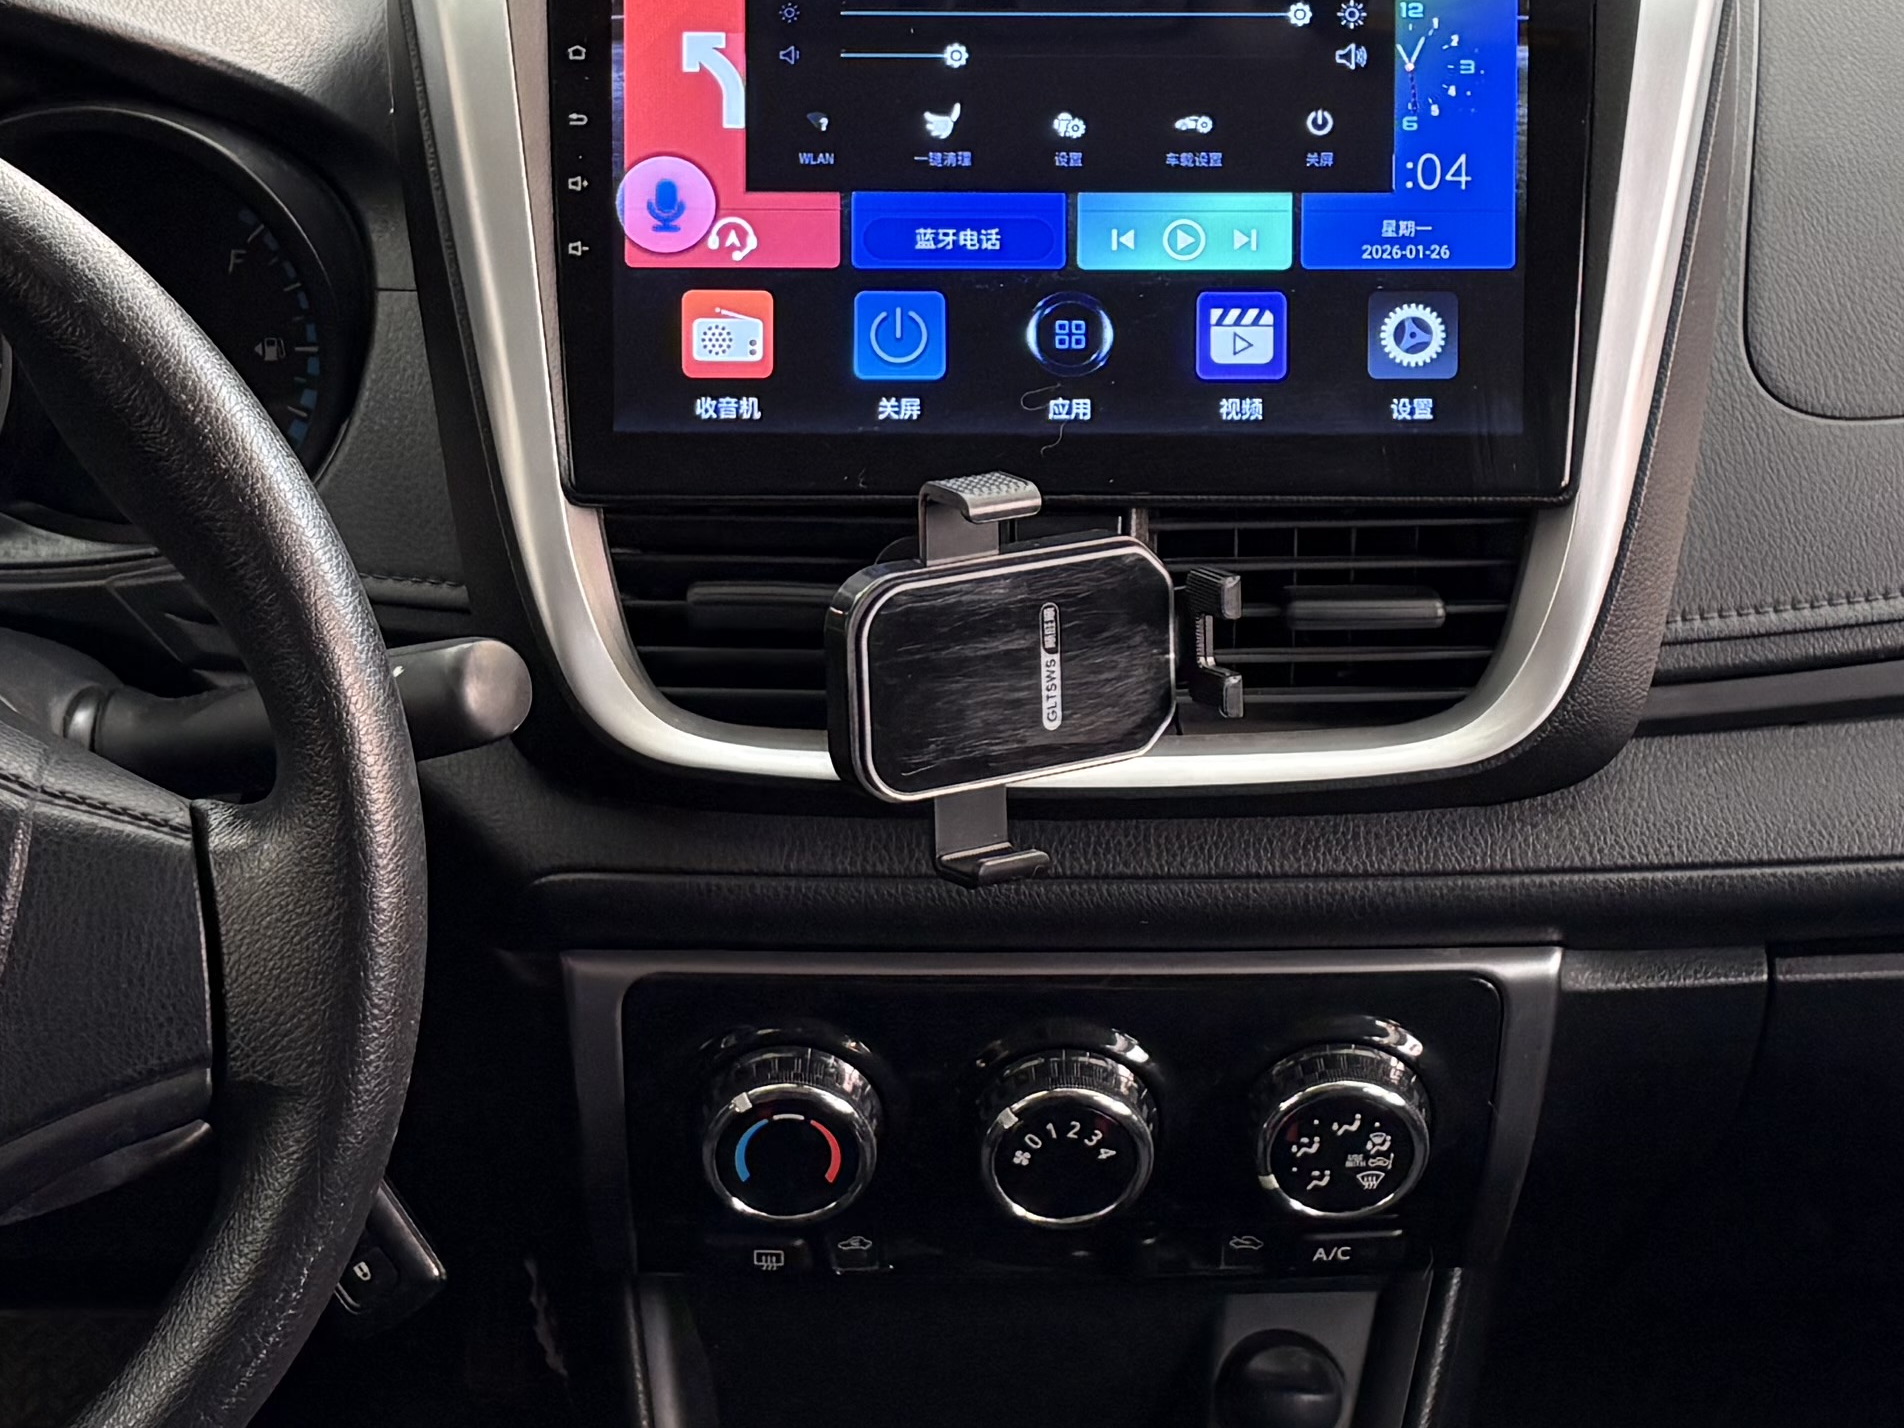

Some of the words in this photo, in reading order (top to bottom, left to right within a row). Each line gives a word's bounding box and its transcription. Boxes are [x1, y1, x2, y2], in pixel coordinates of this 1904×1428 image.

[1399, 1, 1424, 18] 12
[1450, 34, 1459, 47] 2
[1459, 59, 1475, 74] 3
[1402, 116, 1418, 131] 6
[798, 152, 835, 165] WLAN
[1054, 151, 1083, 167] 设置
[1305, 152, 1334, 168] 关屏
[1380, 219, 1433, 238] 星期一
[914, 227, 1001, 251] 蓝牙电话
[228, 249, 247, 273] F
[1361, 244, 1451, 260] 2026-01-26
[696, 397, 762, 420] 收音机
[878, 397, 922, 420] 关屏
[1048, 398, 1092, 420] 应用
[1219, 398, 1264, 421] 视频
[1390, 398, 1434, 421] 设置
[1045, 658, 1058, 722] GLTSWS
[1024, 1133, 1042, 1149] 0
[1045, 1122, 1057, 1139] 1
[1066, 1121, 1081, 1139] 2
[1083, 1130, 1103, 1146] 3
[1097, 1148, 1117, 1160] 4
[1312, 1246, 1352, 1262] A/C
